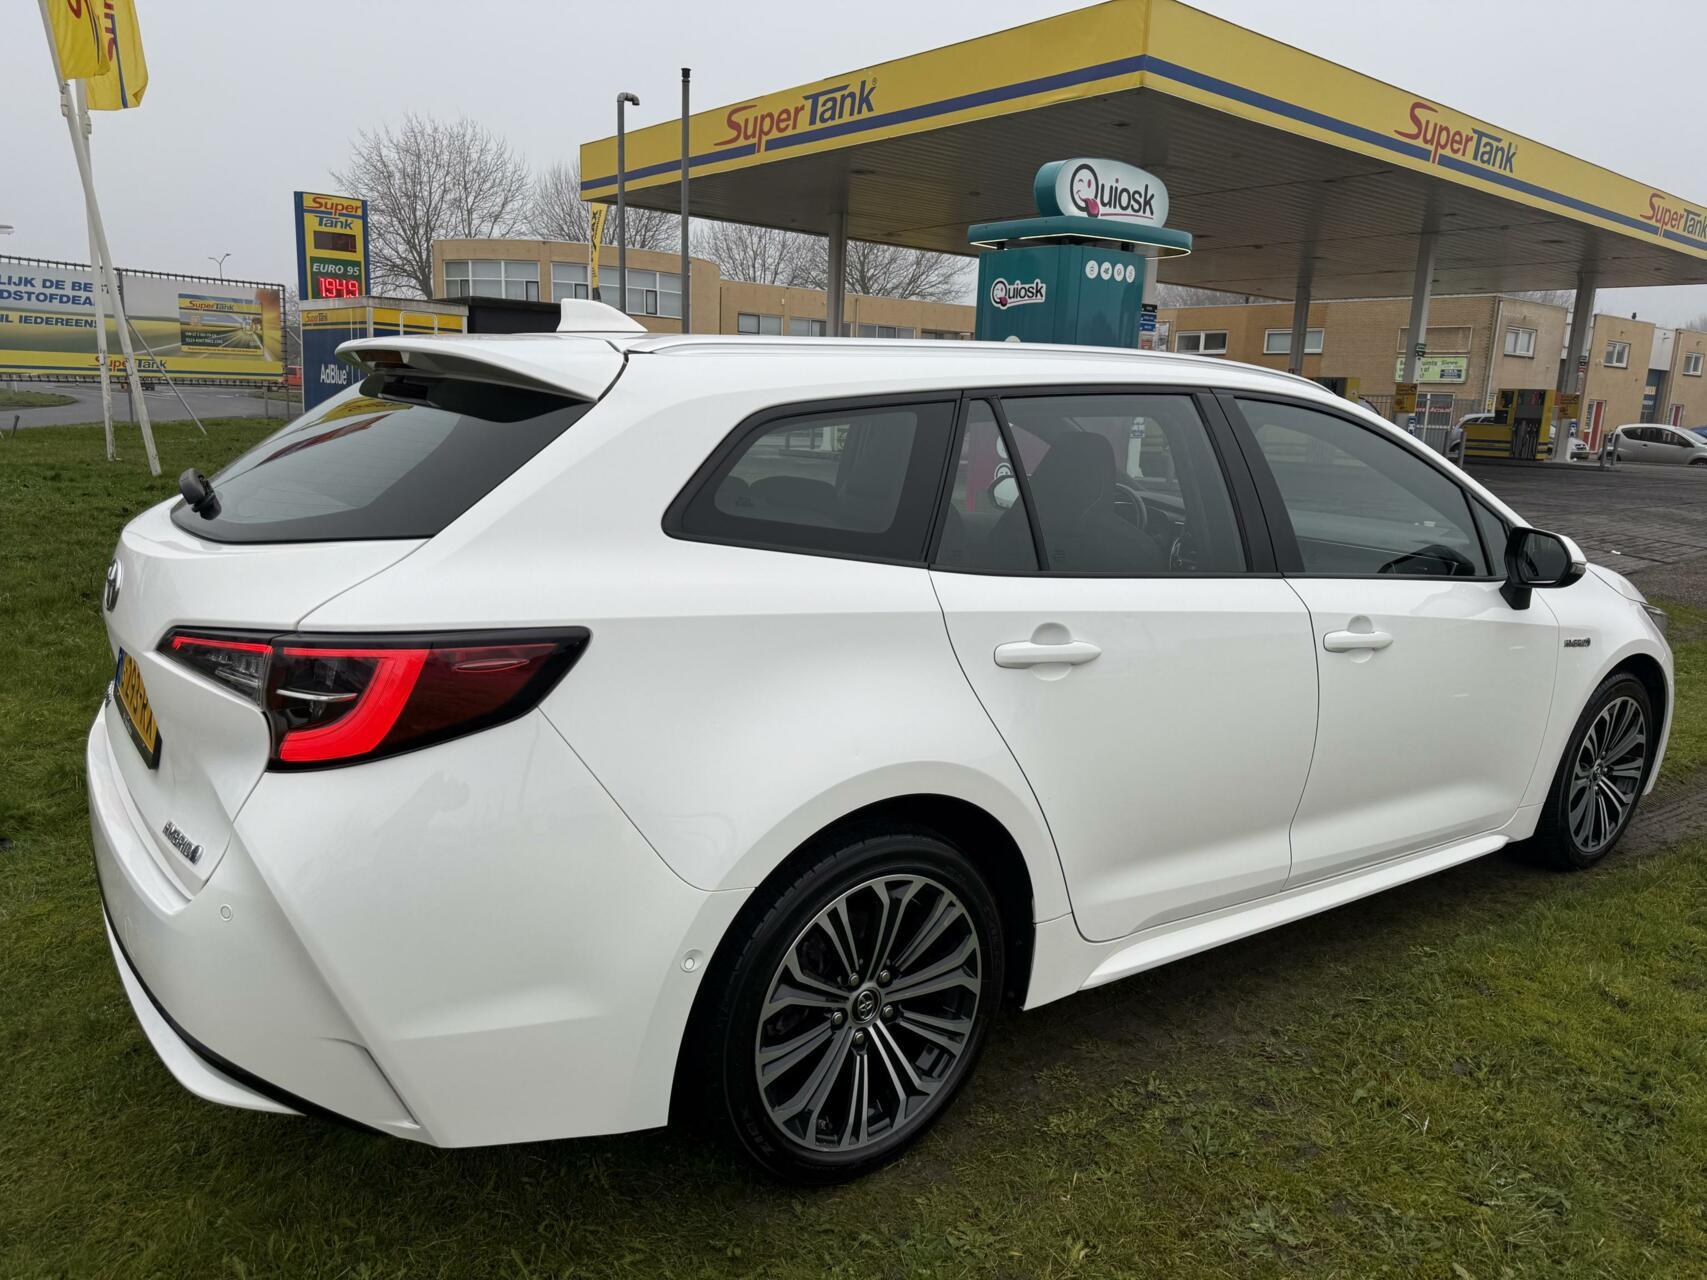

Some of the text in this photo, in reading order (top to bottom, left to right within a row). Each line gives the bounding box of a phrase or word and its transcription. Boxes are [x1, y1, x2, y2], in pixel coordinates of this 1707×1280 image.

[1393, 101, 1517, 173] SuperTank
[1070, 163, 1155, 218] Quiosk
[304, 196, 362, 217] Super
[313, 215, 354, 230] Tank
[312, 263, 360, 276] EURO 95
[42, 279, 66, 290] DE
[992, 280, 1044, 307] Quiosk
[89, 355, 167, 372] SpeTank
[320, 363, 347, 385] AdBlue
